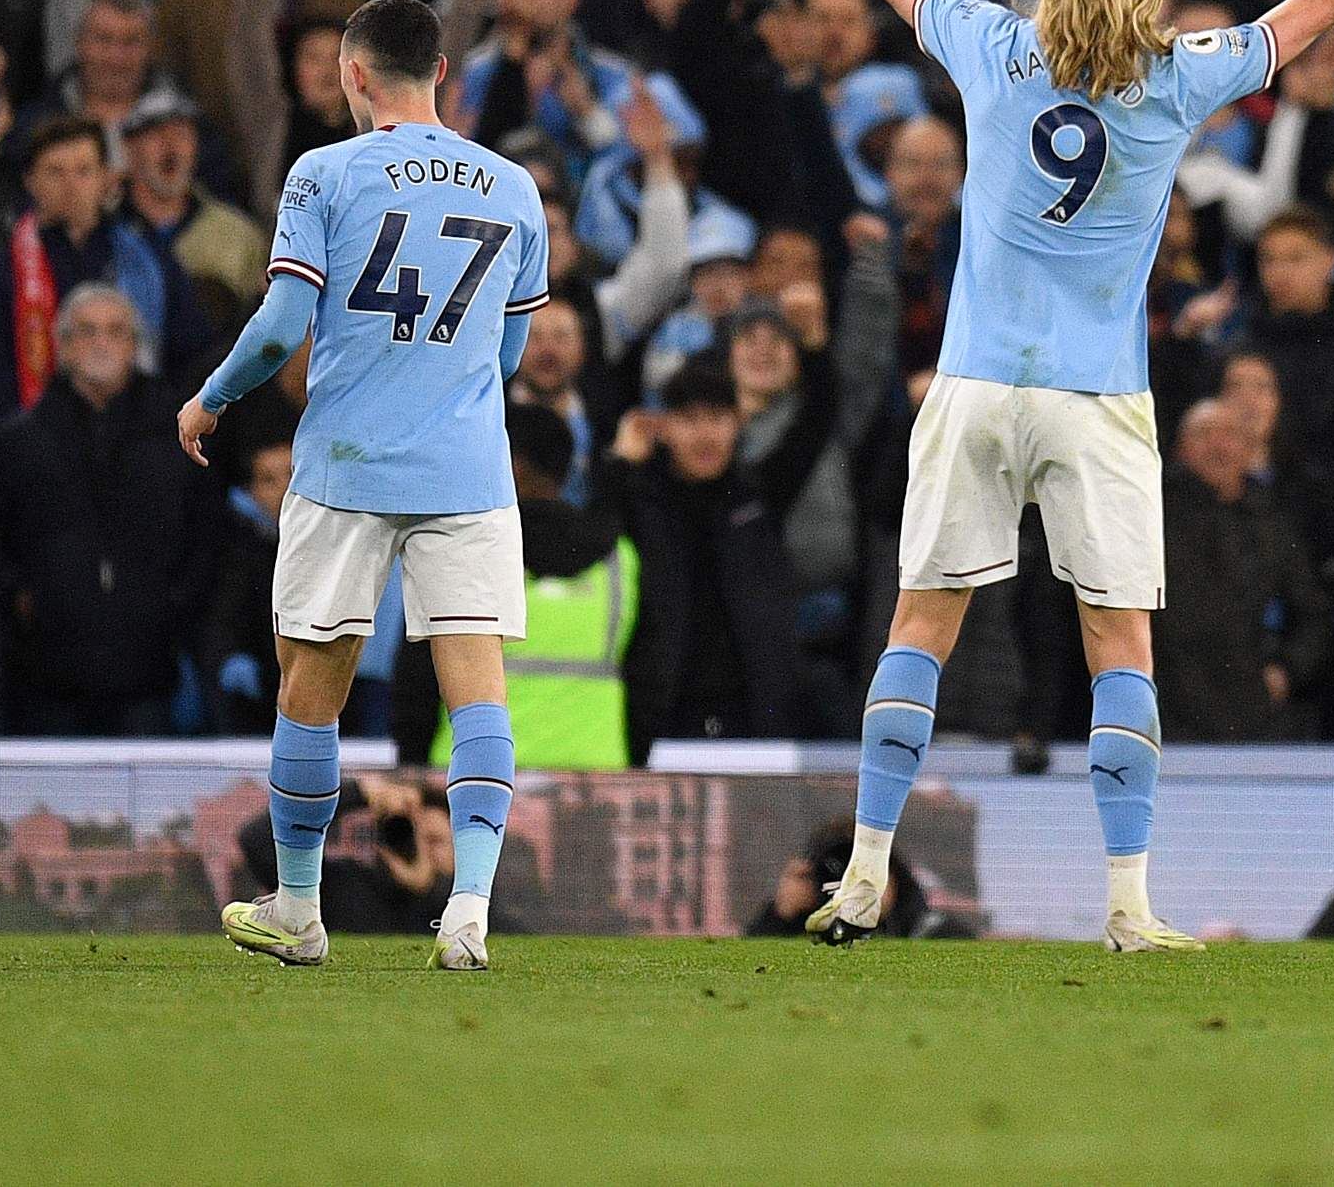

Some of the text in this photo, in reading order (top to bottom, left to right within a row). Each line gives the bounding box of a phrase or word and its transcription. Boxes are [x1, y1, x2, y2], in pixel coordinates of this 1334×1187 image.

[287, 175, 321, 196] EXEN
[385, 158, 496, 197] FODEN
[1029, 101, 1109, 225] 9
[345, 210, 514, 346] 47
